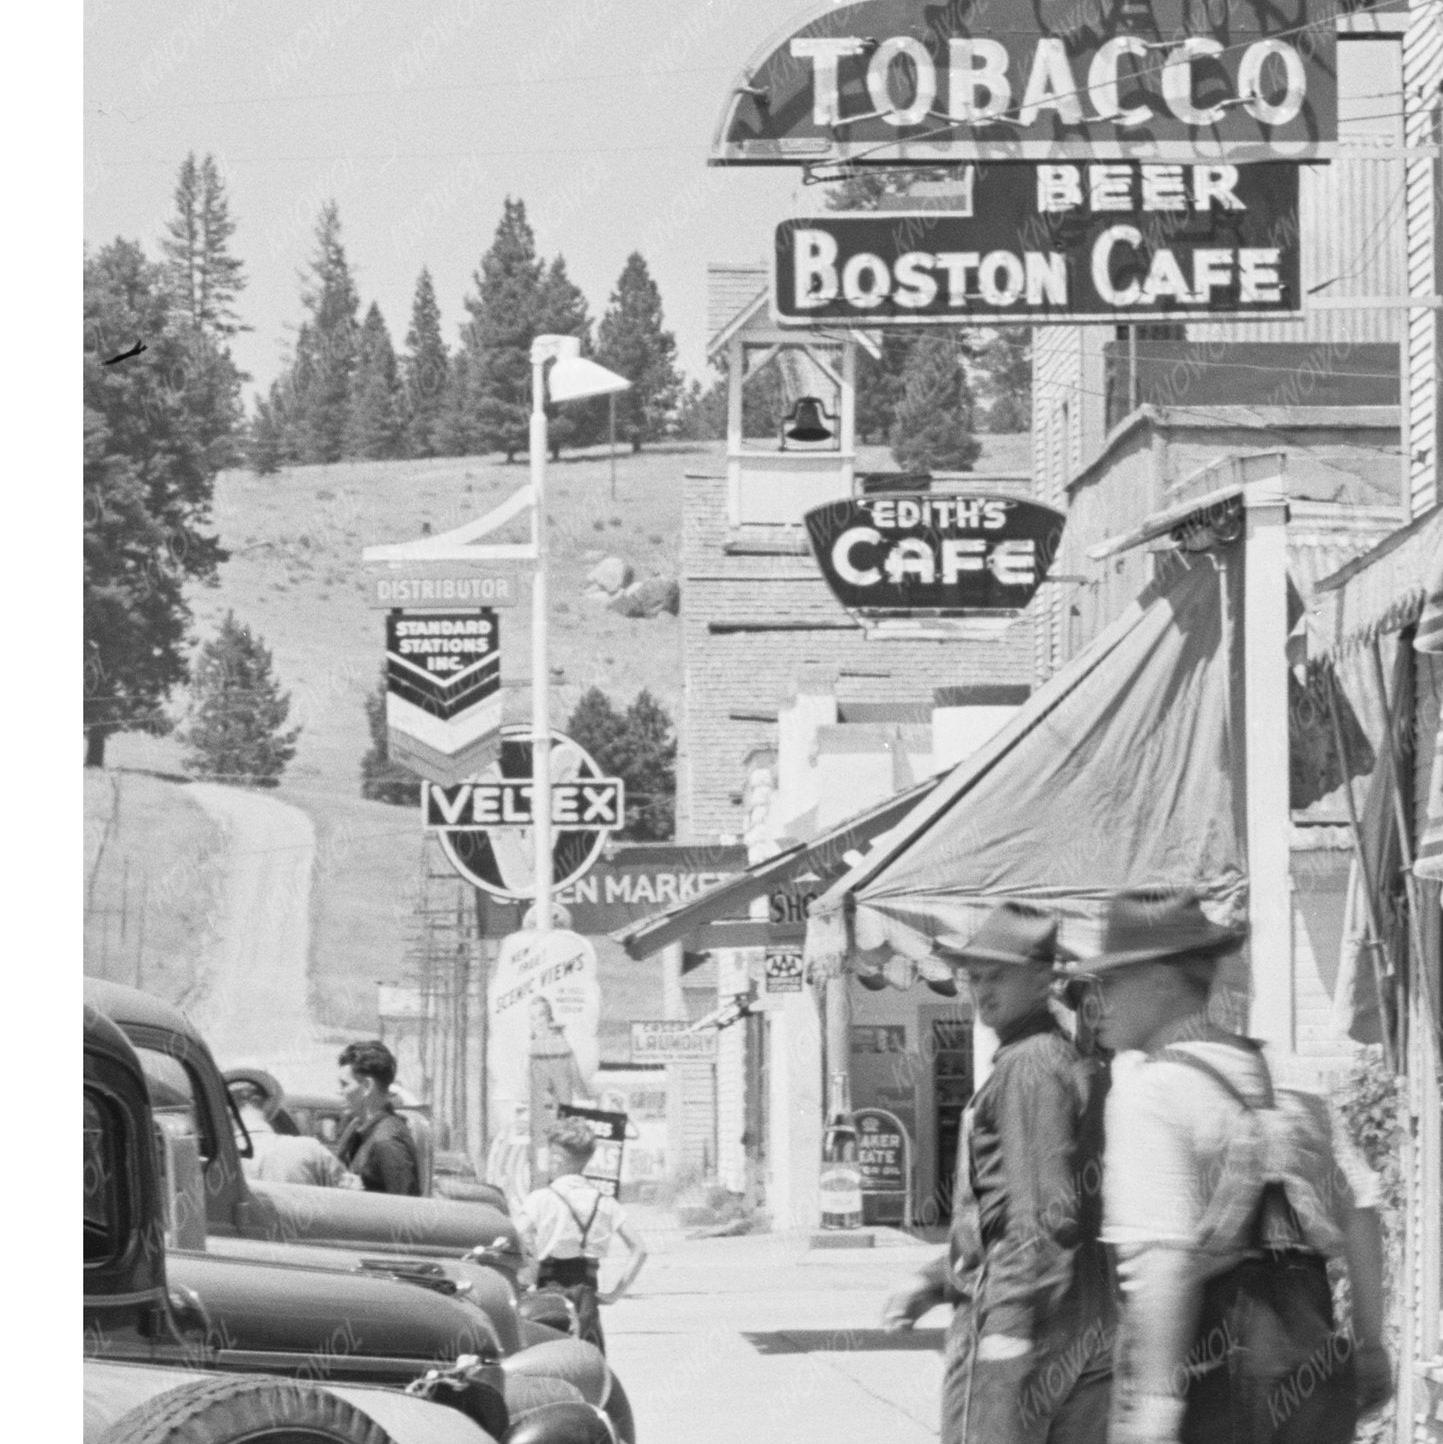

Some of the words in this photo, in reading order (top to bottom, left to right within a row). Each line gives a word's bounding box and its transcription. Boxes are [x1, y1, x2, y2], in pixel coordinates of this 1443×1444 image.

[790, 36, 1308, 127] TOBACCO
[1036, 164, 1247, 213] BEER
[871, 498, 1008, 530] EDITH'S
[831, 529, 1039, 587] CAFE
[377, 578, 509, 599] DISTRIBUTOR
[395, 620, 492, 636] STANDARD
[399, 637, 489, 654] STATIONS
[427, 656, 465, 671] INC.
